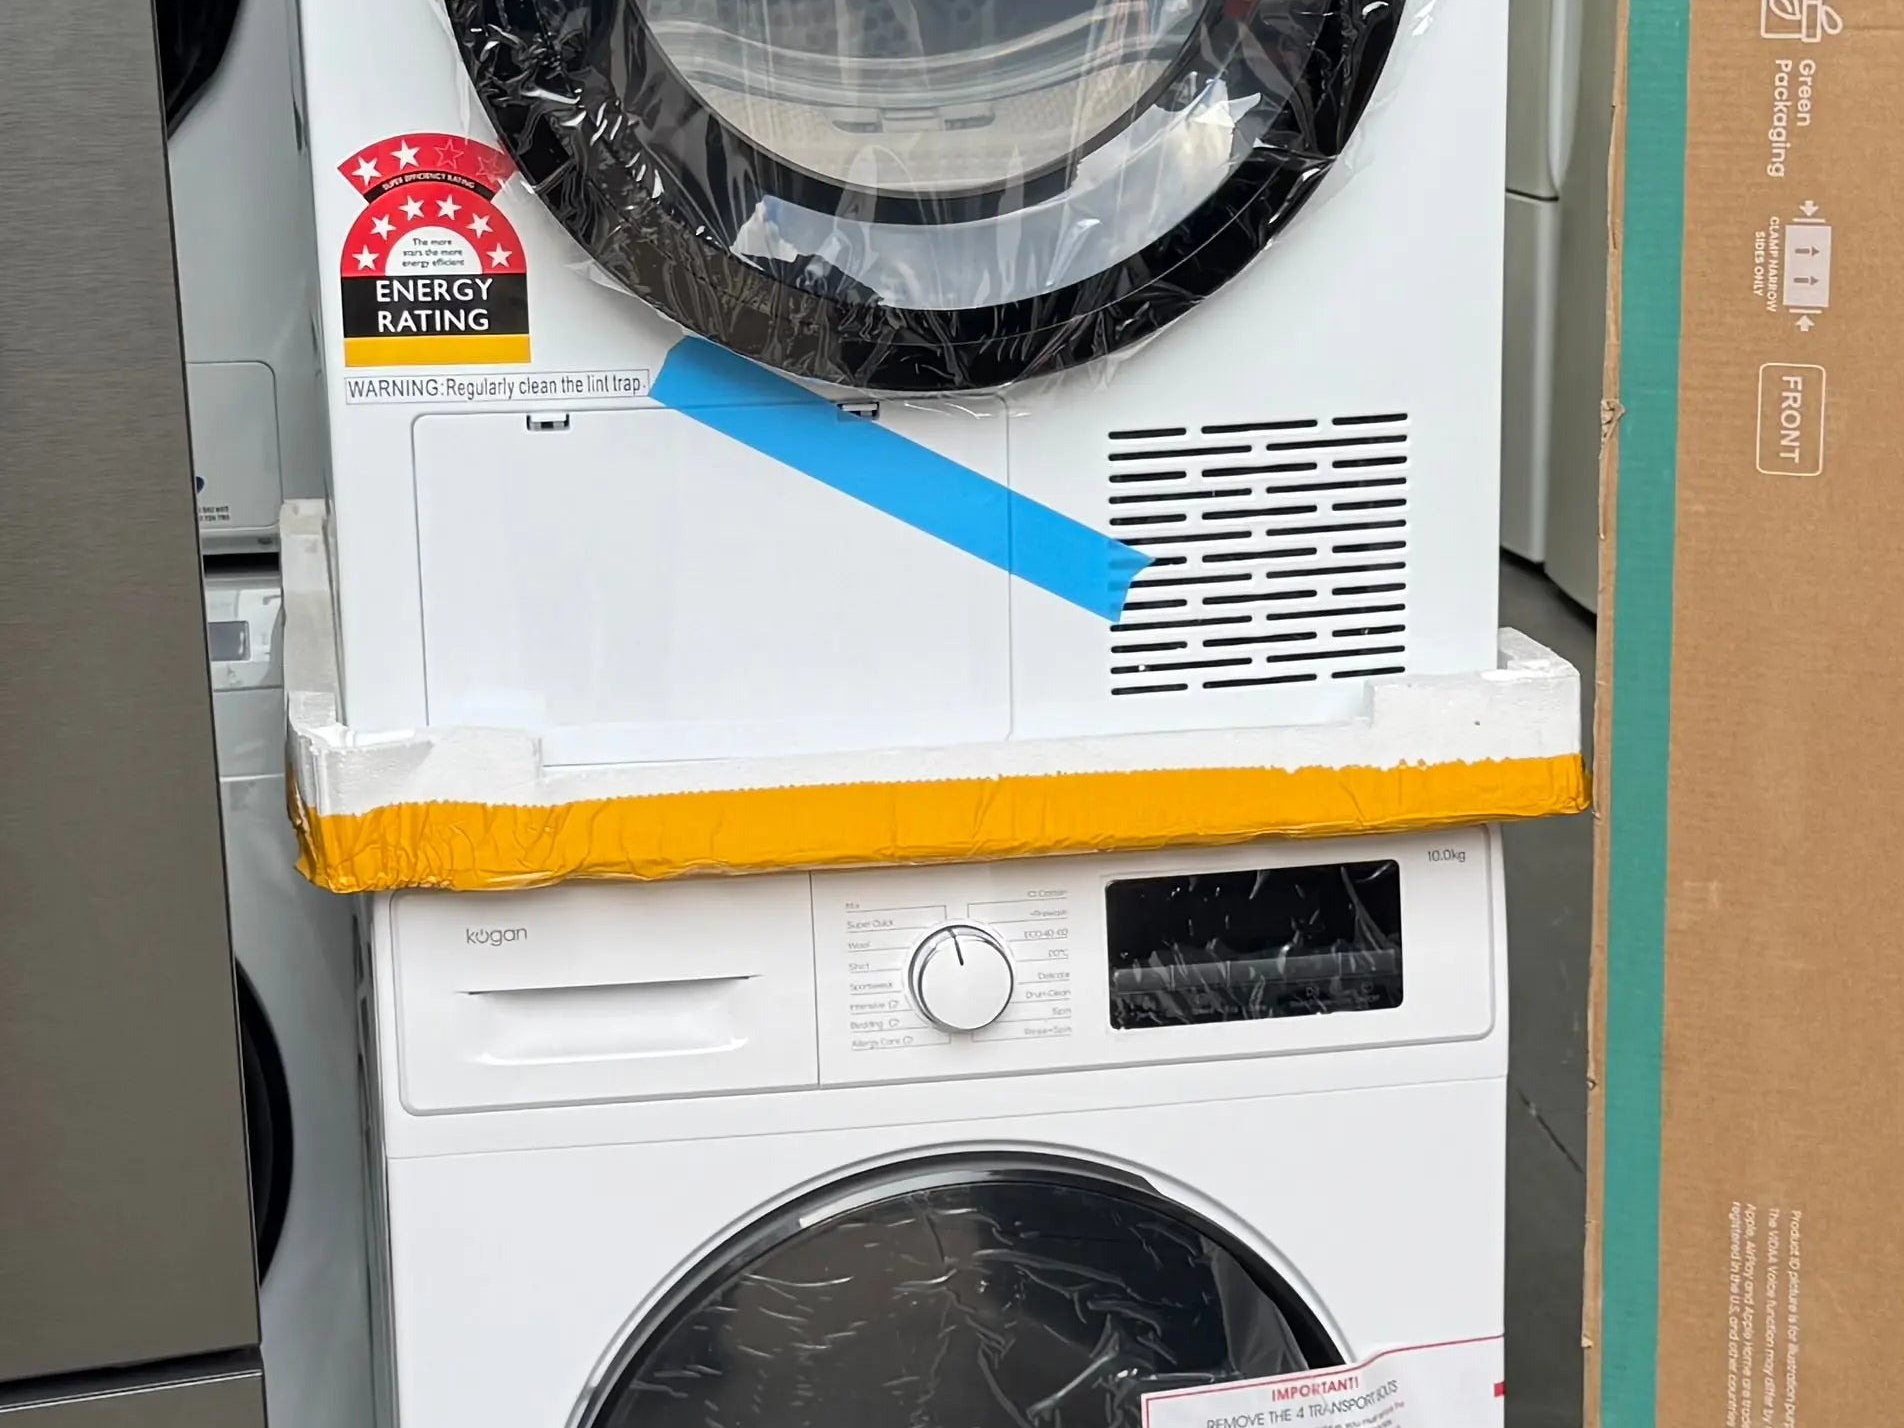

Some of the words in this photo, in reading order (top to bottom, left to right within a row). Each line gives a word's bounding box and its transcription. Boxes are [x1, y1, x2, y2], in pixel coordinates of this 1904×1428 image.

[1797, 60, 1816, 126] Green
[1767, 60, 1792, 177] Packaging
[1755, 232, 1765, 263] SIDES
[376, 278, 492, 302] ENERGY
[1754, 266, 1764, 296] ONLY
[1767, 260, 1778, 312] NARROW
[378, 309, 488, 332] RATING
[519, 377, 556, 394] clean
[562, 376, 583, 393] the
[1780, 377, 1802, 463] FRONT
[1427, 849, 1466, 863] 10.0kg
[466, 928, 527, 947] kogan
[1271, 1376, 1359, 1403] IMPORTANT!
[1269, 1409, 1292, 1423] THE
[1296, 1406, 1305, 1419] 4
[1308, 1393, 1377, 1418] TRANSPORT
